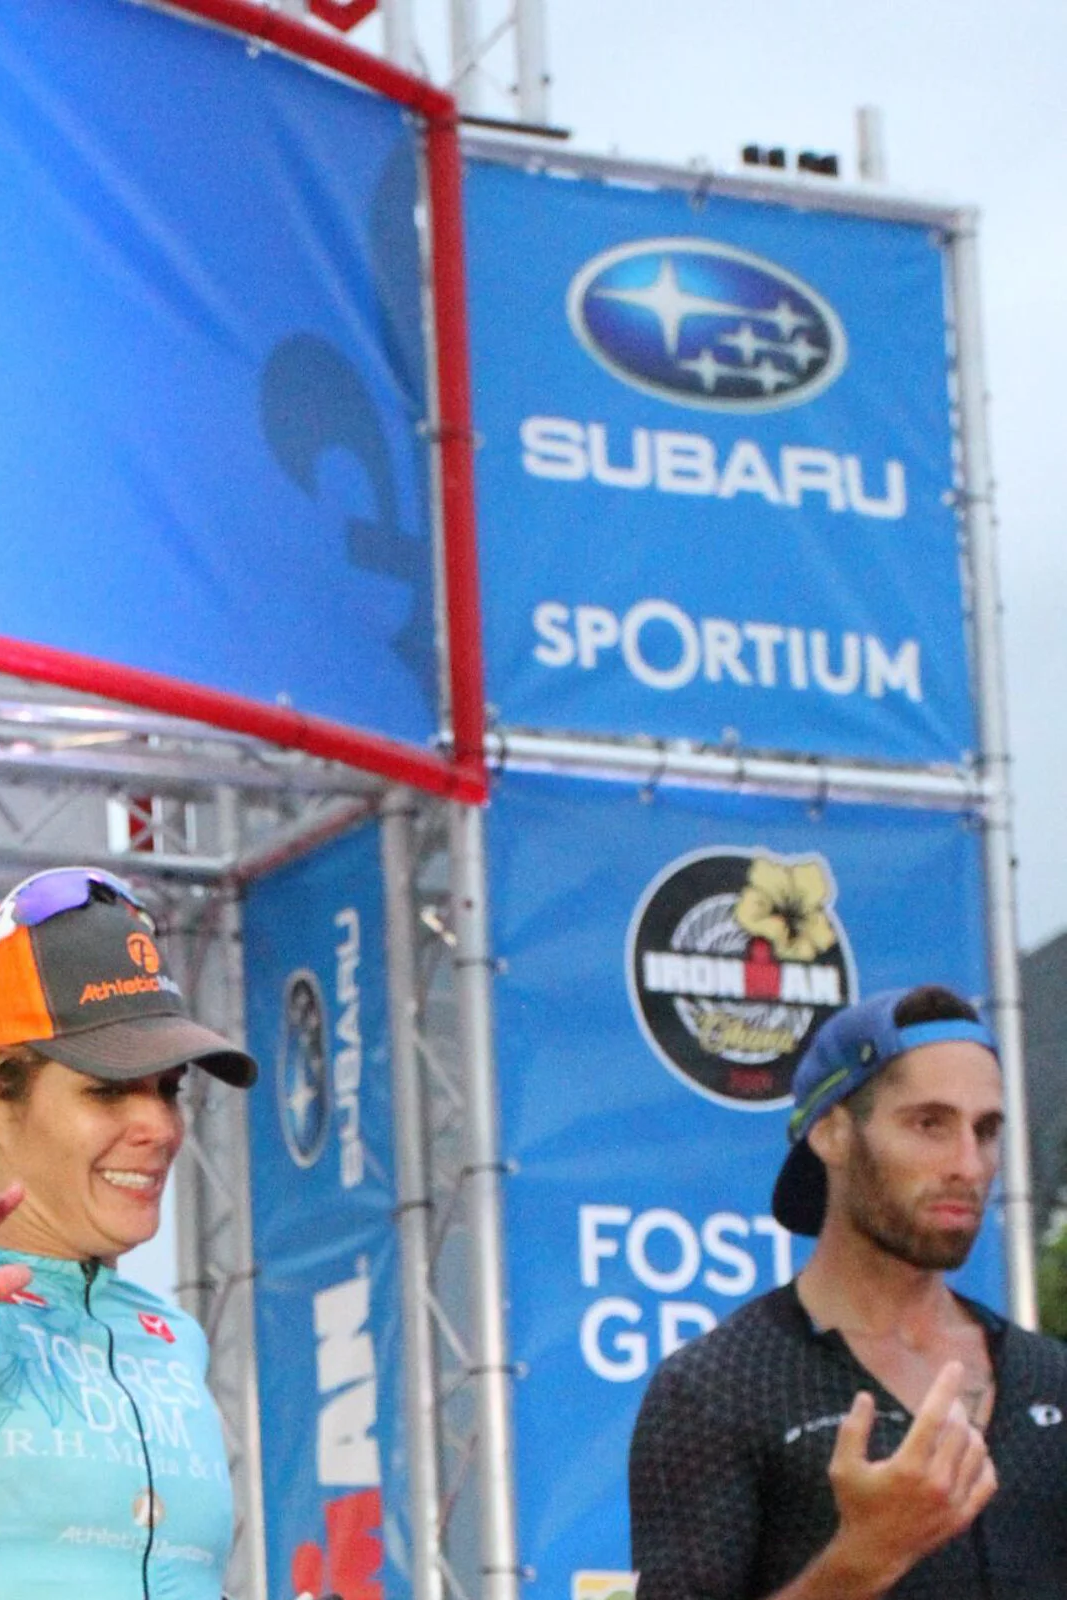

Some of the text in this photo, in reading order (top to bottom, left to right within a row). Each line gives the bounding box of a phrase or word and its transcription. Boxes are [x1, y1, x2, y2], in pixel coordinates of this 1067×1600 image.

[520, 416, 907, 520] SUBARU
[533, 599, 923, 702] SPORTIUM
[643, 942, 842, 1007] IRONMAN
[335, 906, 365, 1189] SUBARU
[17, 1322, 201, 1409] TORRES
